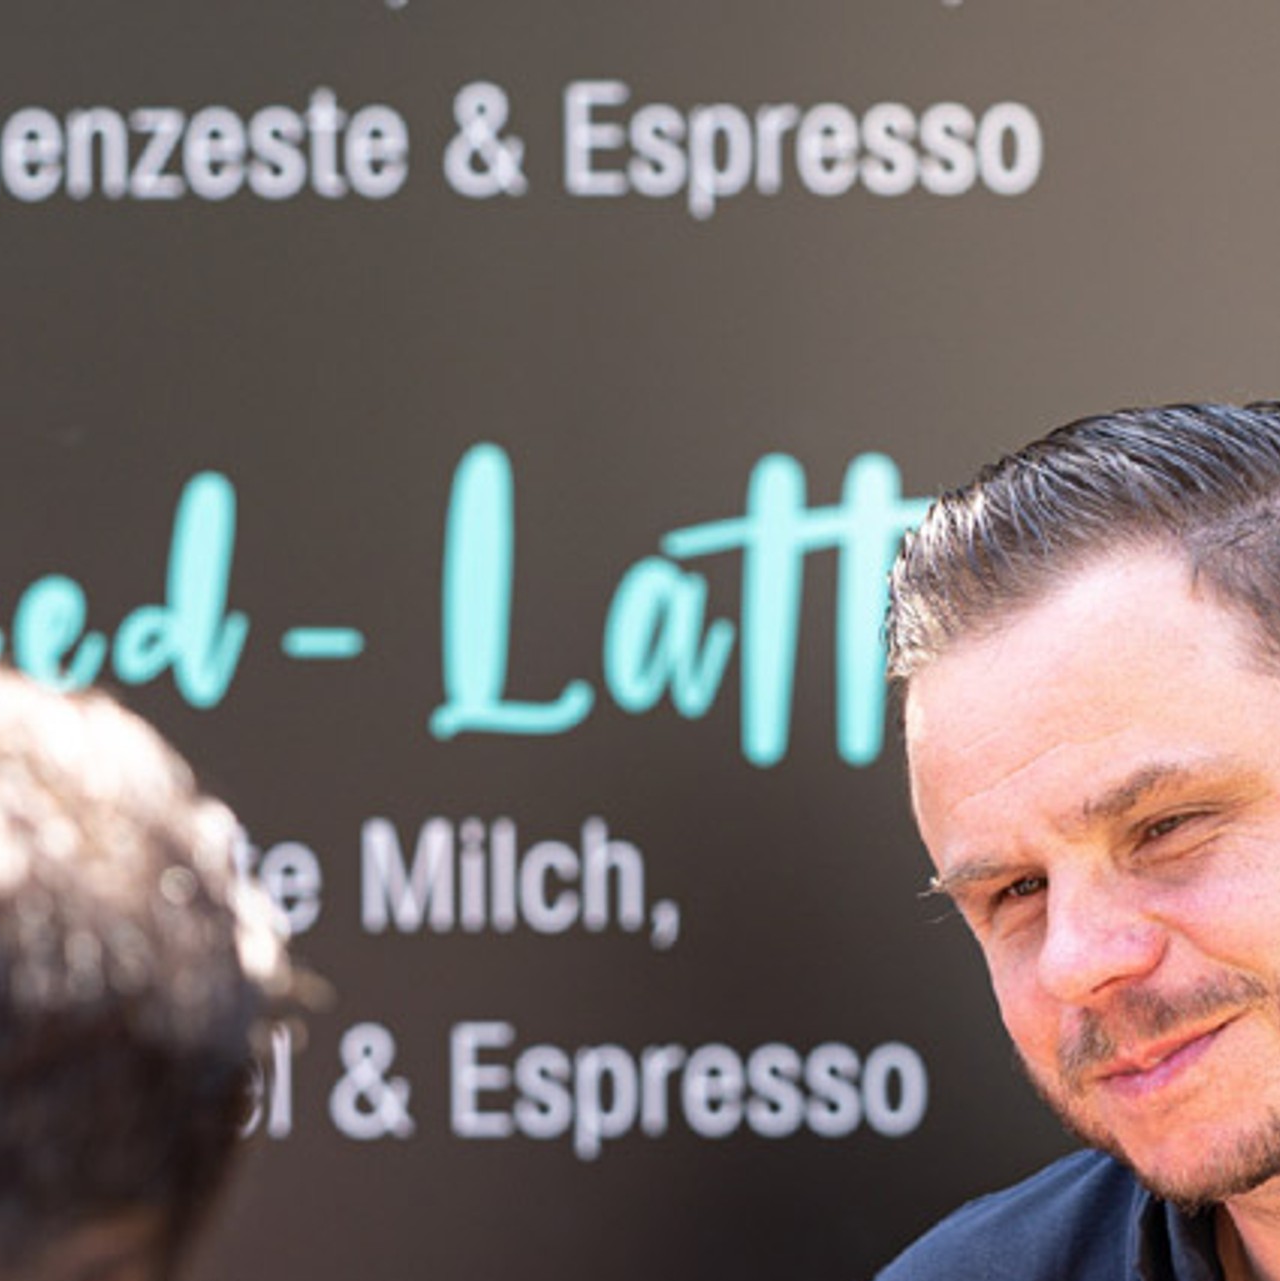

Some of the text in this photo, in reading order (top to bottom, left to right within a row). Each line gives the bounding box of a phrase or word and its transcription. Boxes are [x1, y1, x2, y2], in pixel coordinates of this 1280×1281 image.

[442, 81, 527, 197] &
[563, 81, 1045, 219] Espresso
[360, 816, 682, 950] Milch,
[328, 1020, 418, 1140] &
[449, 1020, 928, 1162] Espresso
